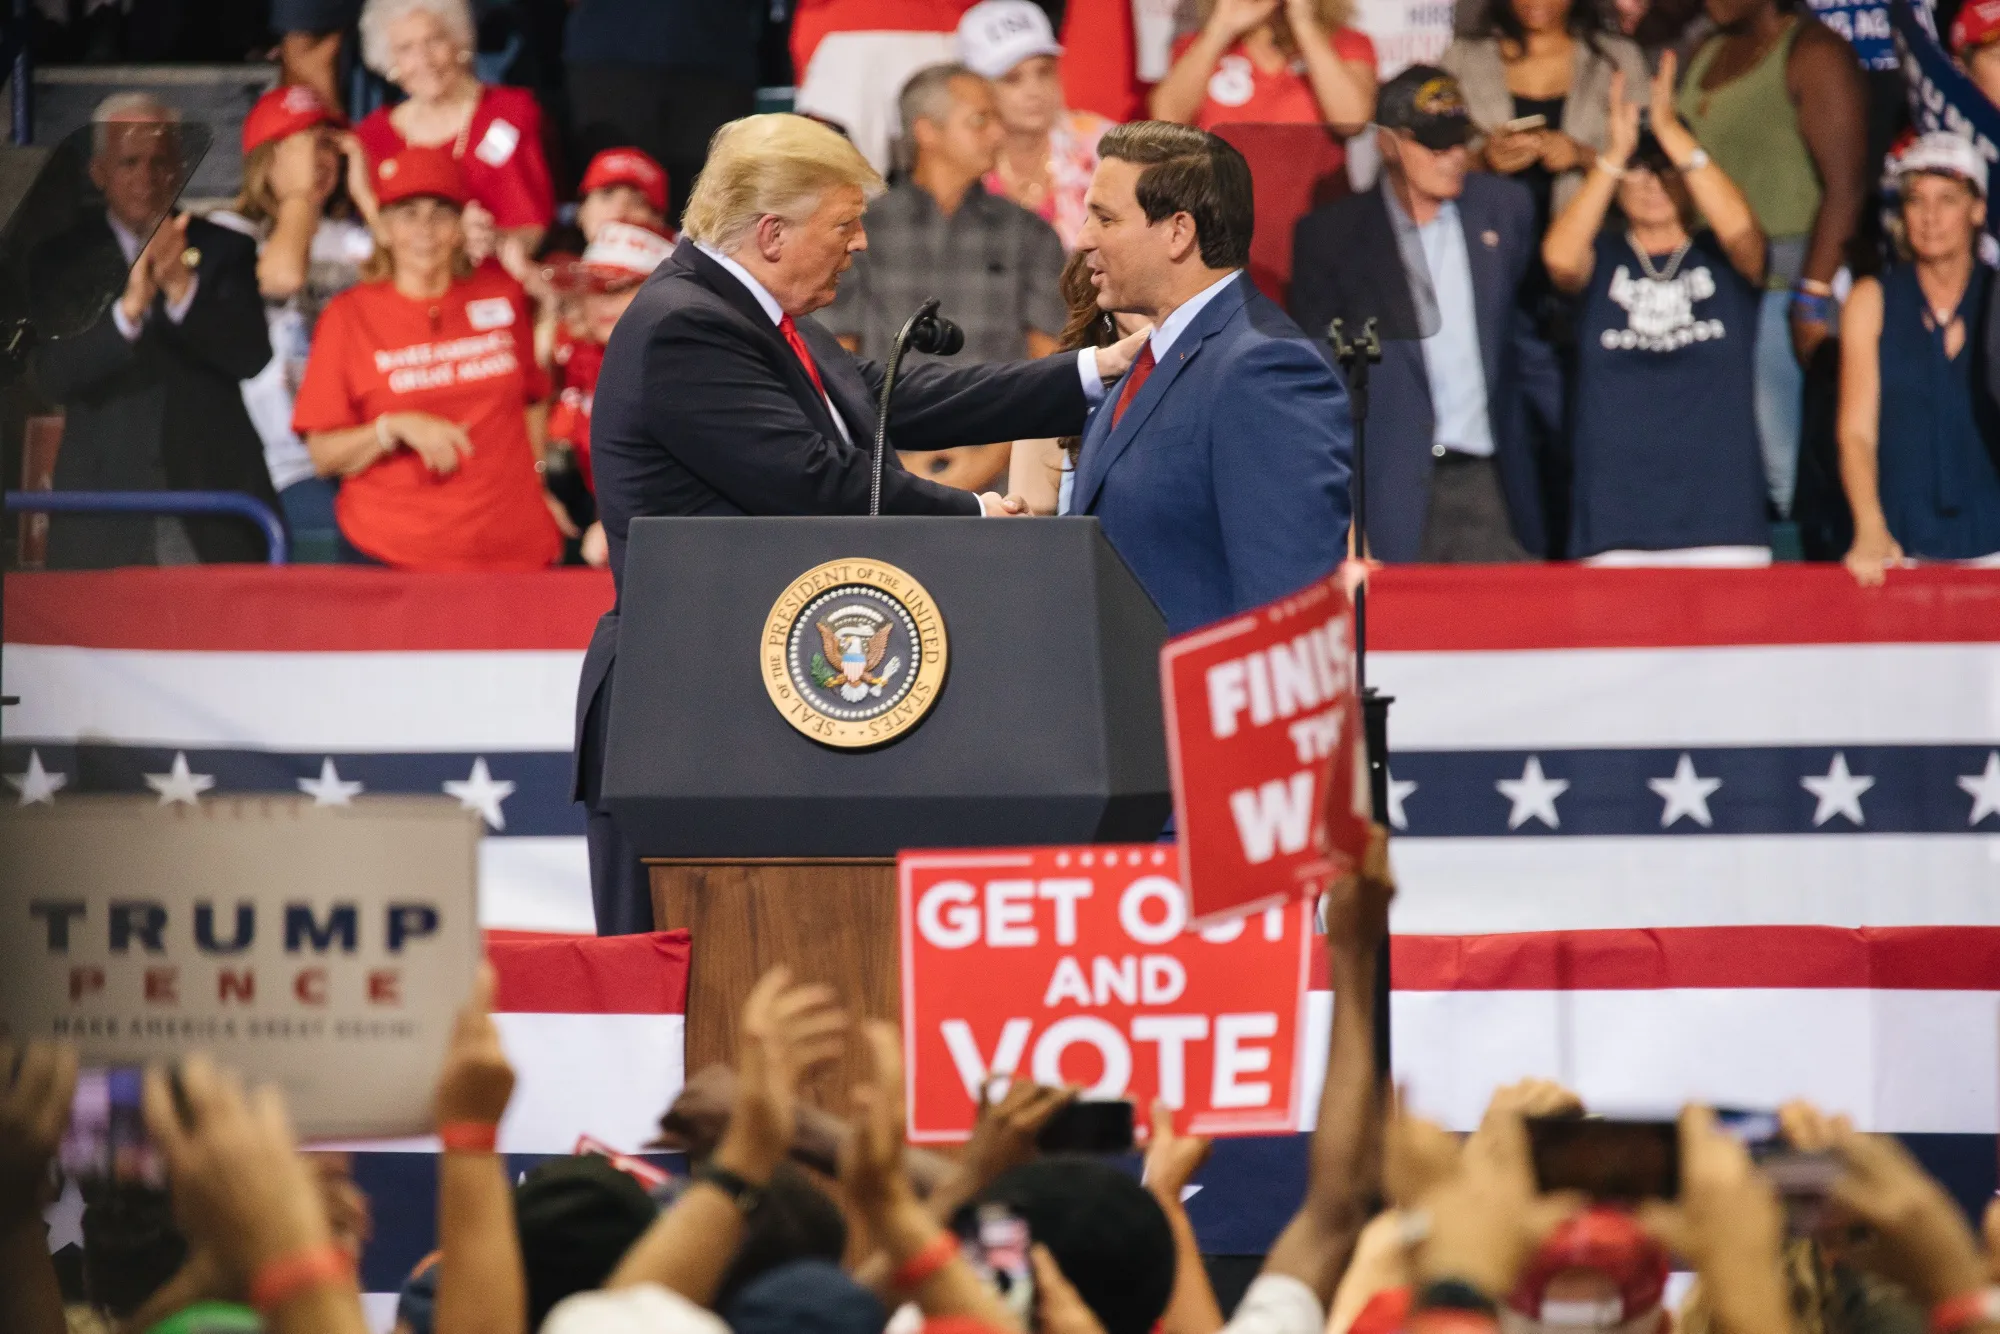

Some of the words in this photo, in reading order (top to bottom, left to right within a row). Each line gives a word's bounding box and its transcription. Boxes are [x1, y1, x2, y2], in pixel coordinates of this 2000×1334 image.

[856, 567, 874, 580] OF
[877, 571, 901, 590] THE
[768, 565, 851, 647] PRESIDENT
[904, 588, 940, 664] UNITED
[770, 655, 783, 680] THE
[777, 682, 791, 699] OF
[1205, 614, 1350, 739] FINIS
[790, 697, 836, 737] SEAL
[868, 680, 932, 737] STATES
[1288, 707, 1347, 765] TH
[1229, 769, 1325, 865] W
[29, 899, 442, 956] TRUMP
[916, 878, 1094, 949] GET
[67, 966, 404, 1007] PENCE
[1043, 953, 1188, 1008] AND
[939, 1011, 1280, 1112] VOTE
